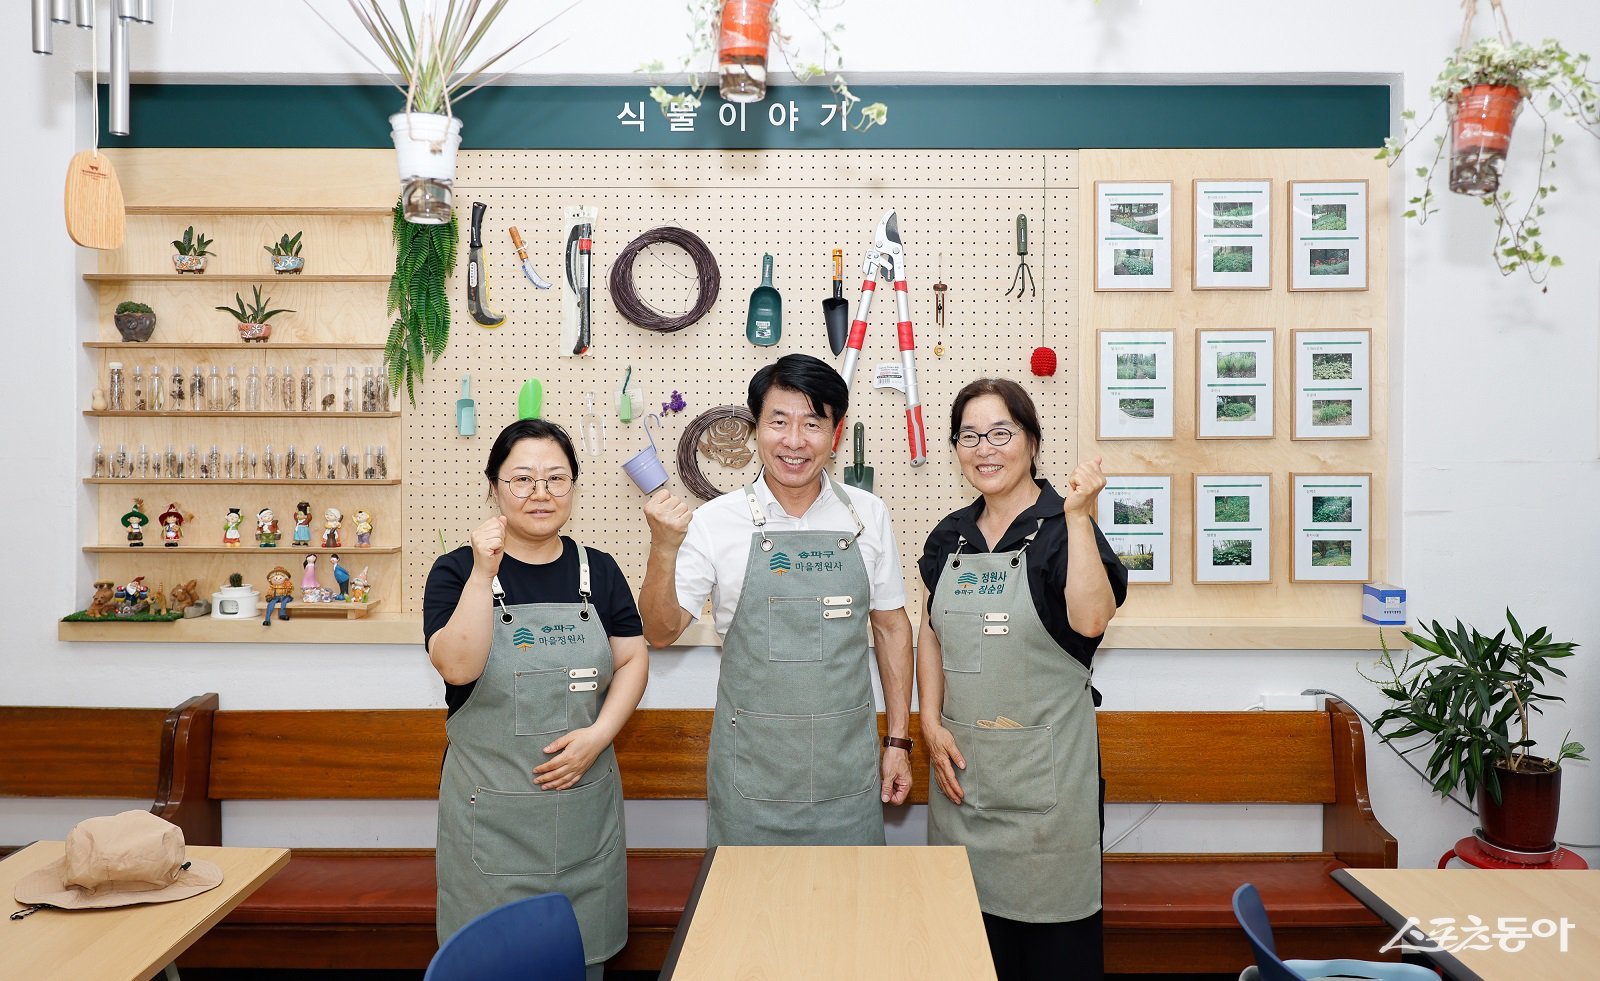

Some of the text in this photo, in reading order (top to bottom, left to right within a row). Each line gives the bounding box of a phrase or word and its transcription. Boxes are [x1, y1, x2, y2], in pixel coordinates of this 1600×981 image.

[798, 551, 834, 559] 송파구
[795, 561, 843, 572] 마을정원사
[981, 571, 1007, 583] 정원사
[541, 624, 576, 633] 송파구
[539, 634, 585, 646] 마을정원사
